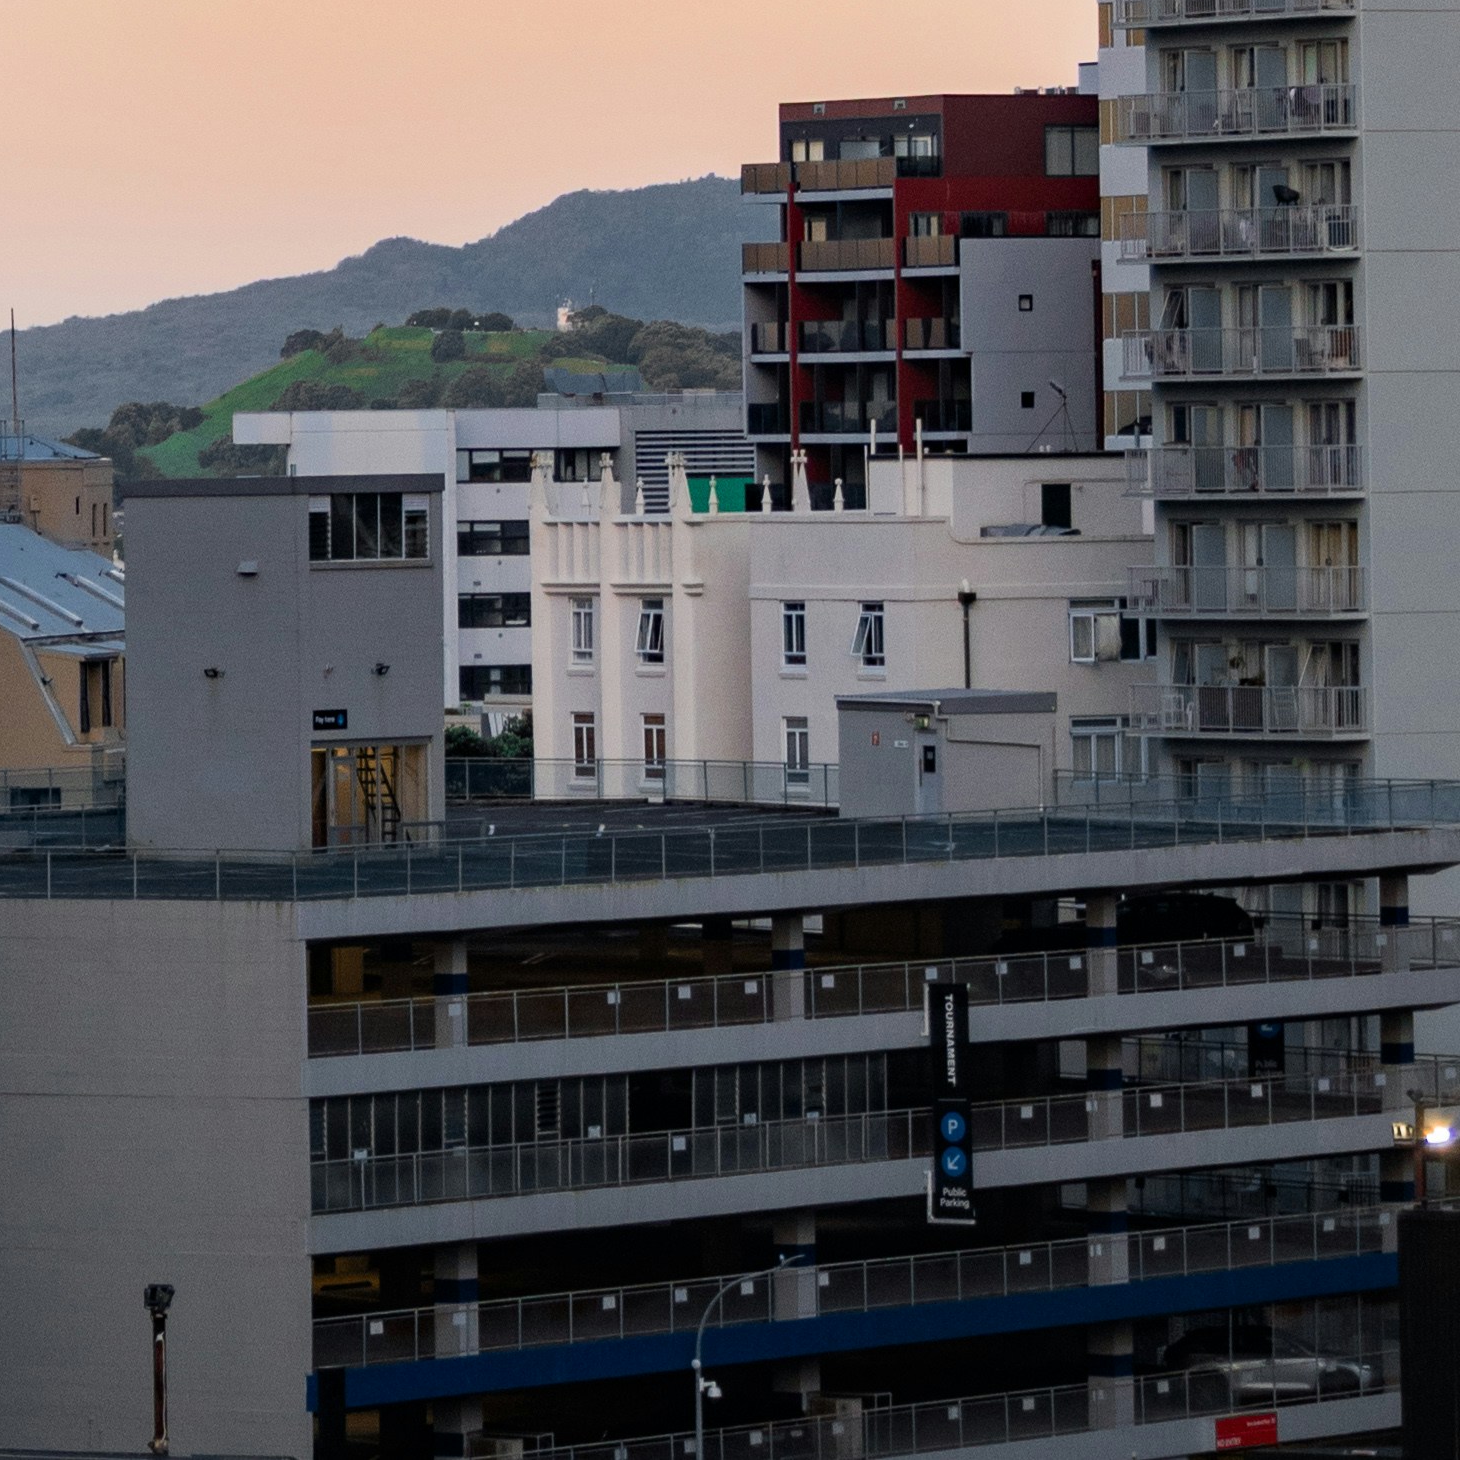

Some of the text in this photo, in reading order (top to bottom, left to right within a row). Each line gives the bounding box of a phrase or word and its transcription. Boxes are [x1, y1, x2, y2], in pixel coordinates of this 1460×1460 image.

[945, 994, 956, 1087] TOURNAMENT
[948, 1119, 958, 1135] P
[943, 1187, 967, 1197] Public
[940, 1198, 970, 1209] Parking
